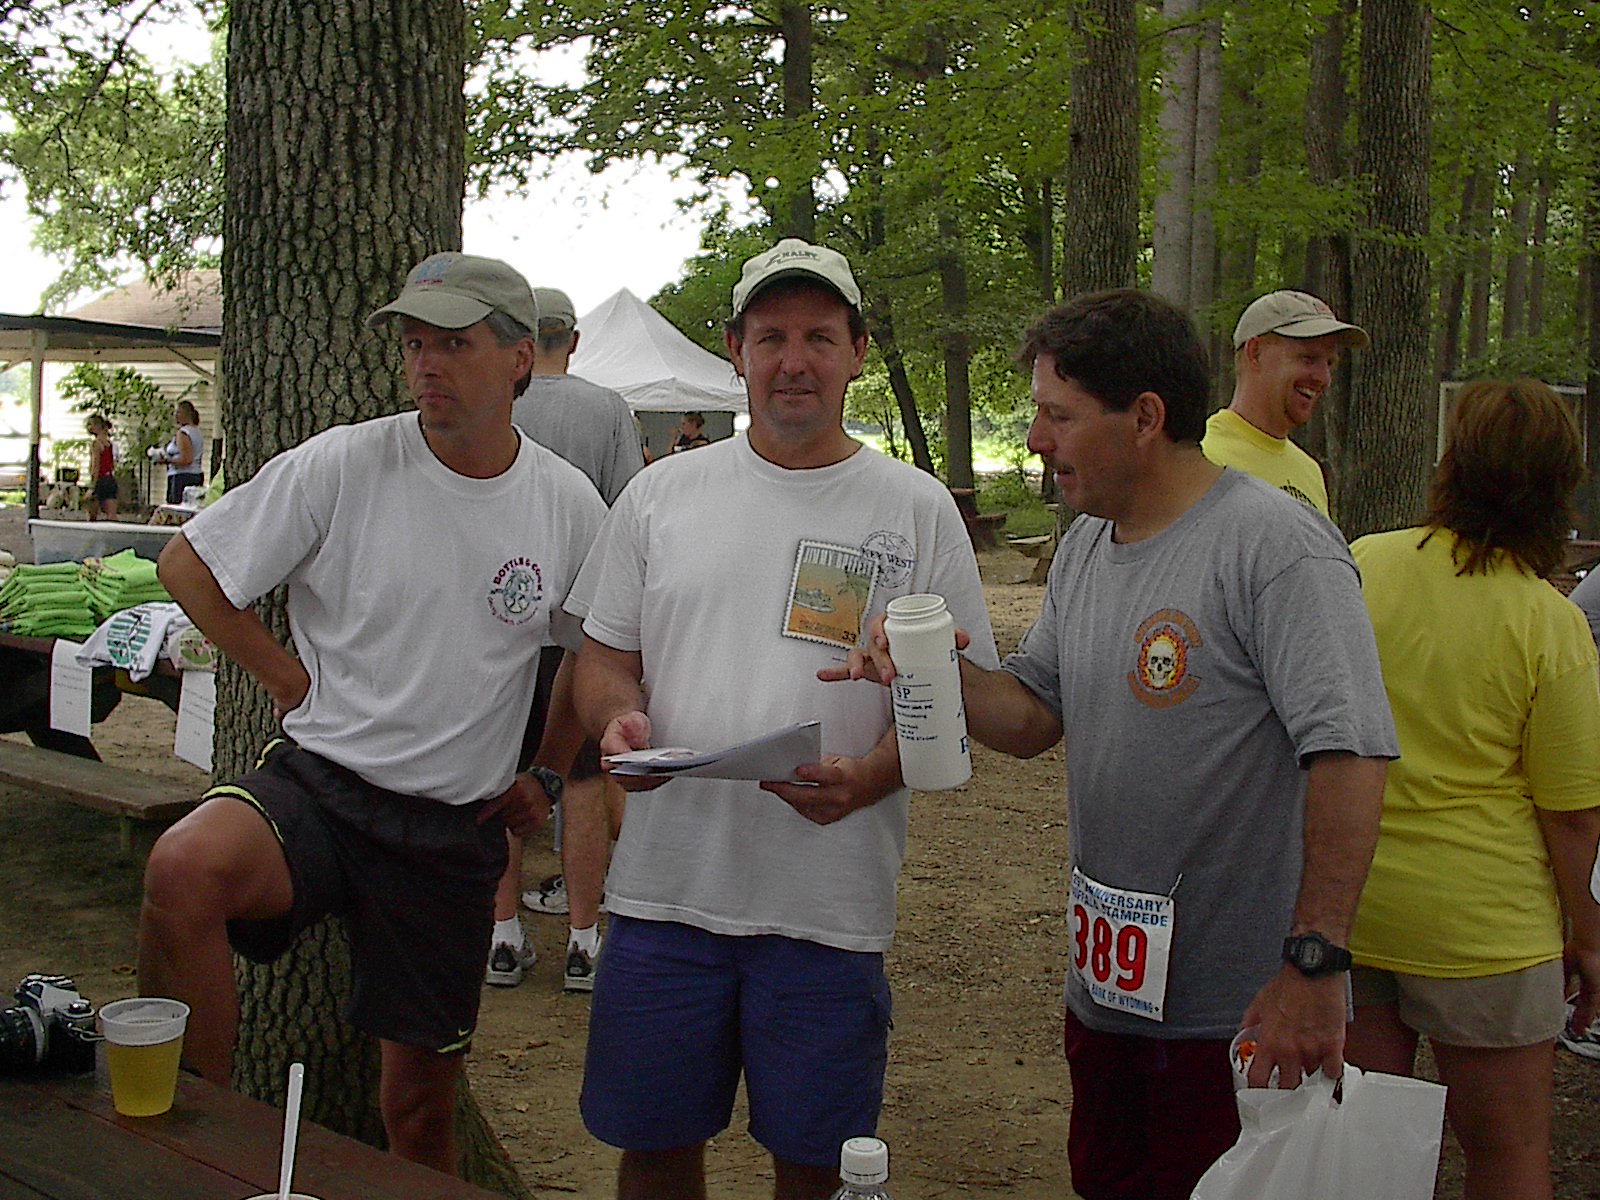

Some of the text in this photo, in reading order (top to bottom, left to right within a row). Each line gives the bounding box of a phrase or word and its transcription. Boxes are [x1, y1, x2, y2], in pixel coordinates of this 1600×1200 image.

[803, 546, 833, 567] JIMMY
[861, 547, 915, 569] KEY WEST
[493, 557, 524, 585] BOTTLE
[1085, 882, 1164, 913] ANNIVERSARY
[1101, 904, 1168, 927] STAMPEDE
[1074, 904, 1148, 992] 389
[1107, 991, 1117, 1004] OF
[1118, 994, 1154, 1014] WYOMING
